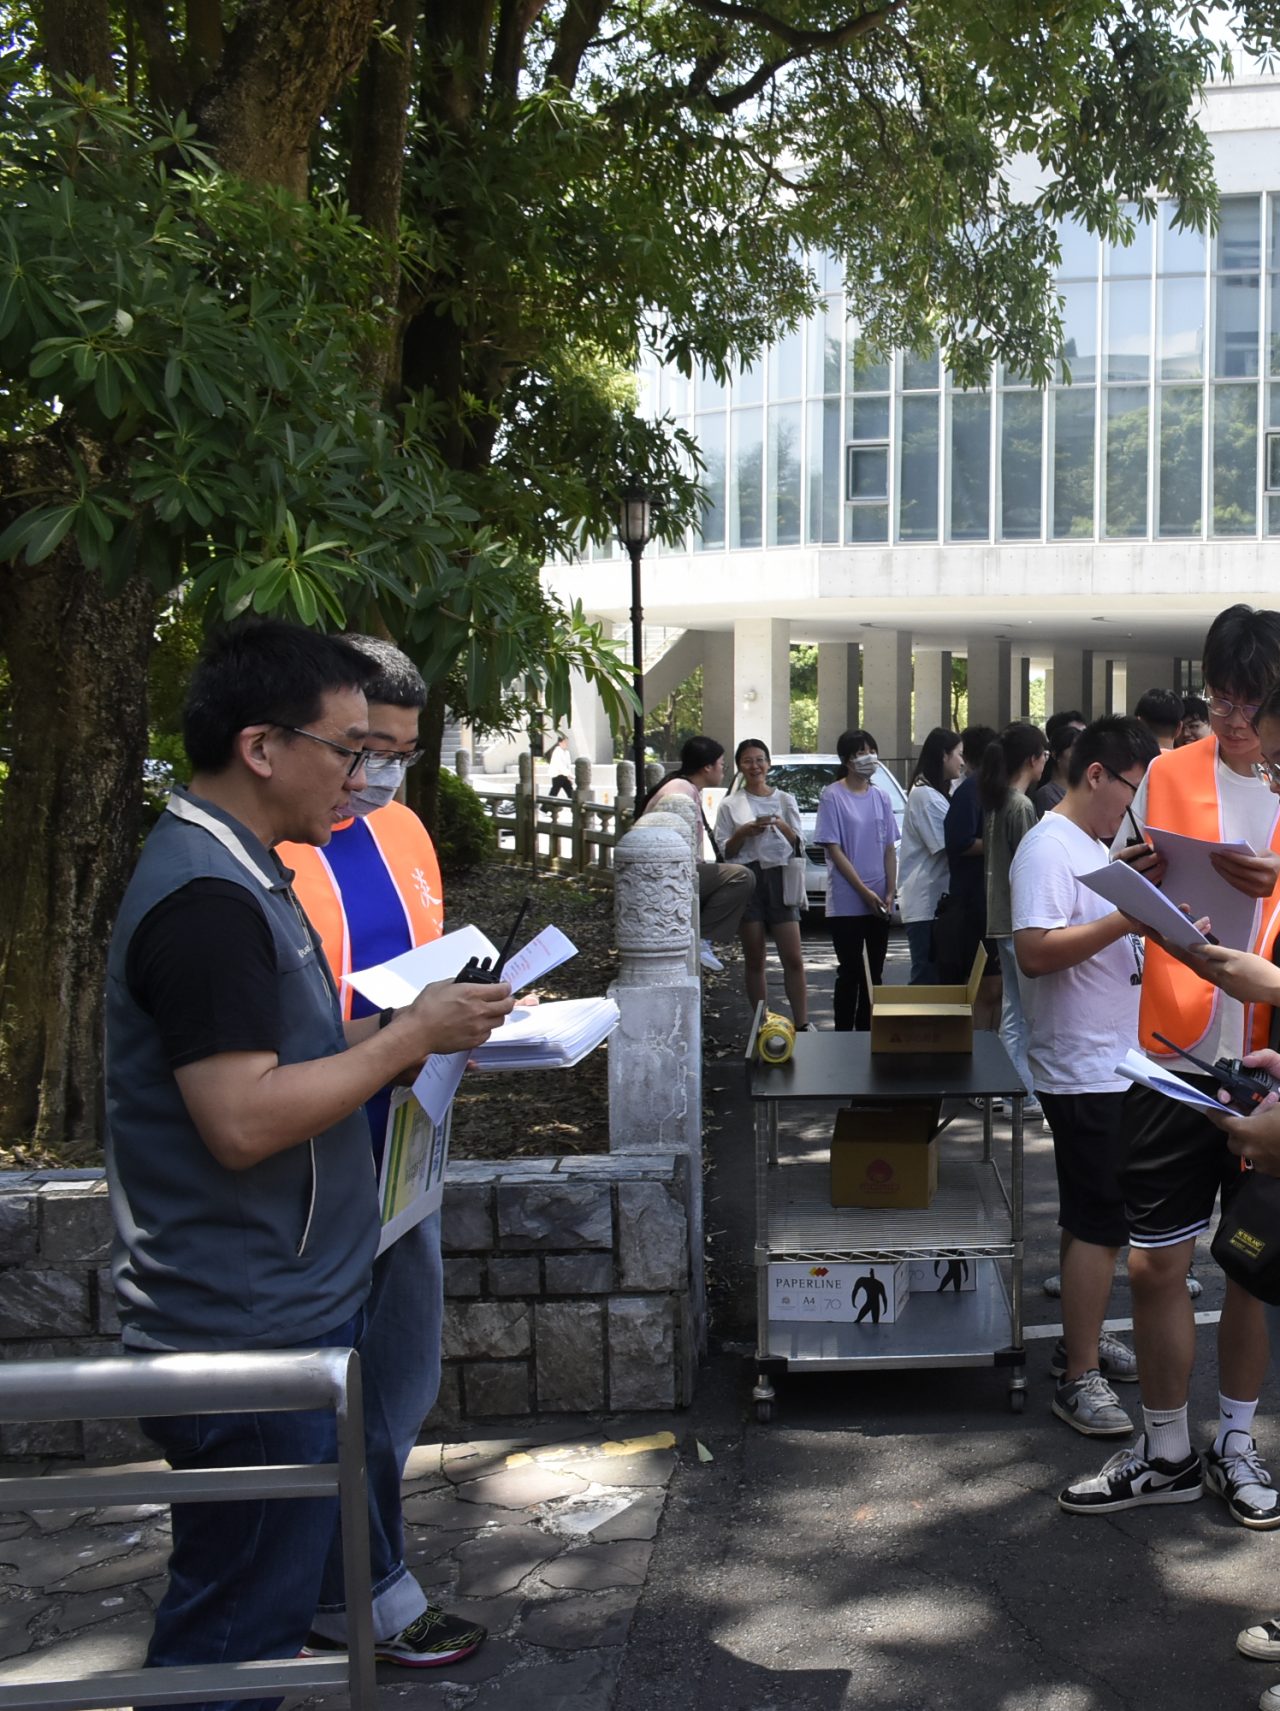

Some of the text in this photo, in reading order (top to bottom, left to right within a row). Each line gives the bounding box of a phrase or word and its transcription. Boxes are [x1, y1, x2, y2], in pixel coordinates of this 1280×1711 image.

[776, 1278, 842, 1290] PAPERLINE
[803, 1296, 842, 1310] A4 70
